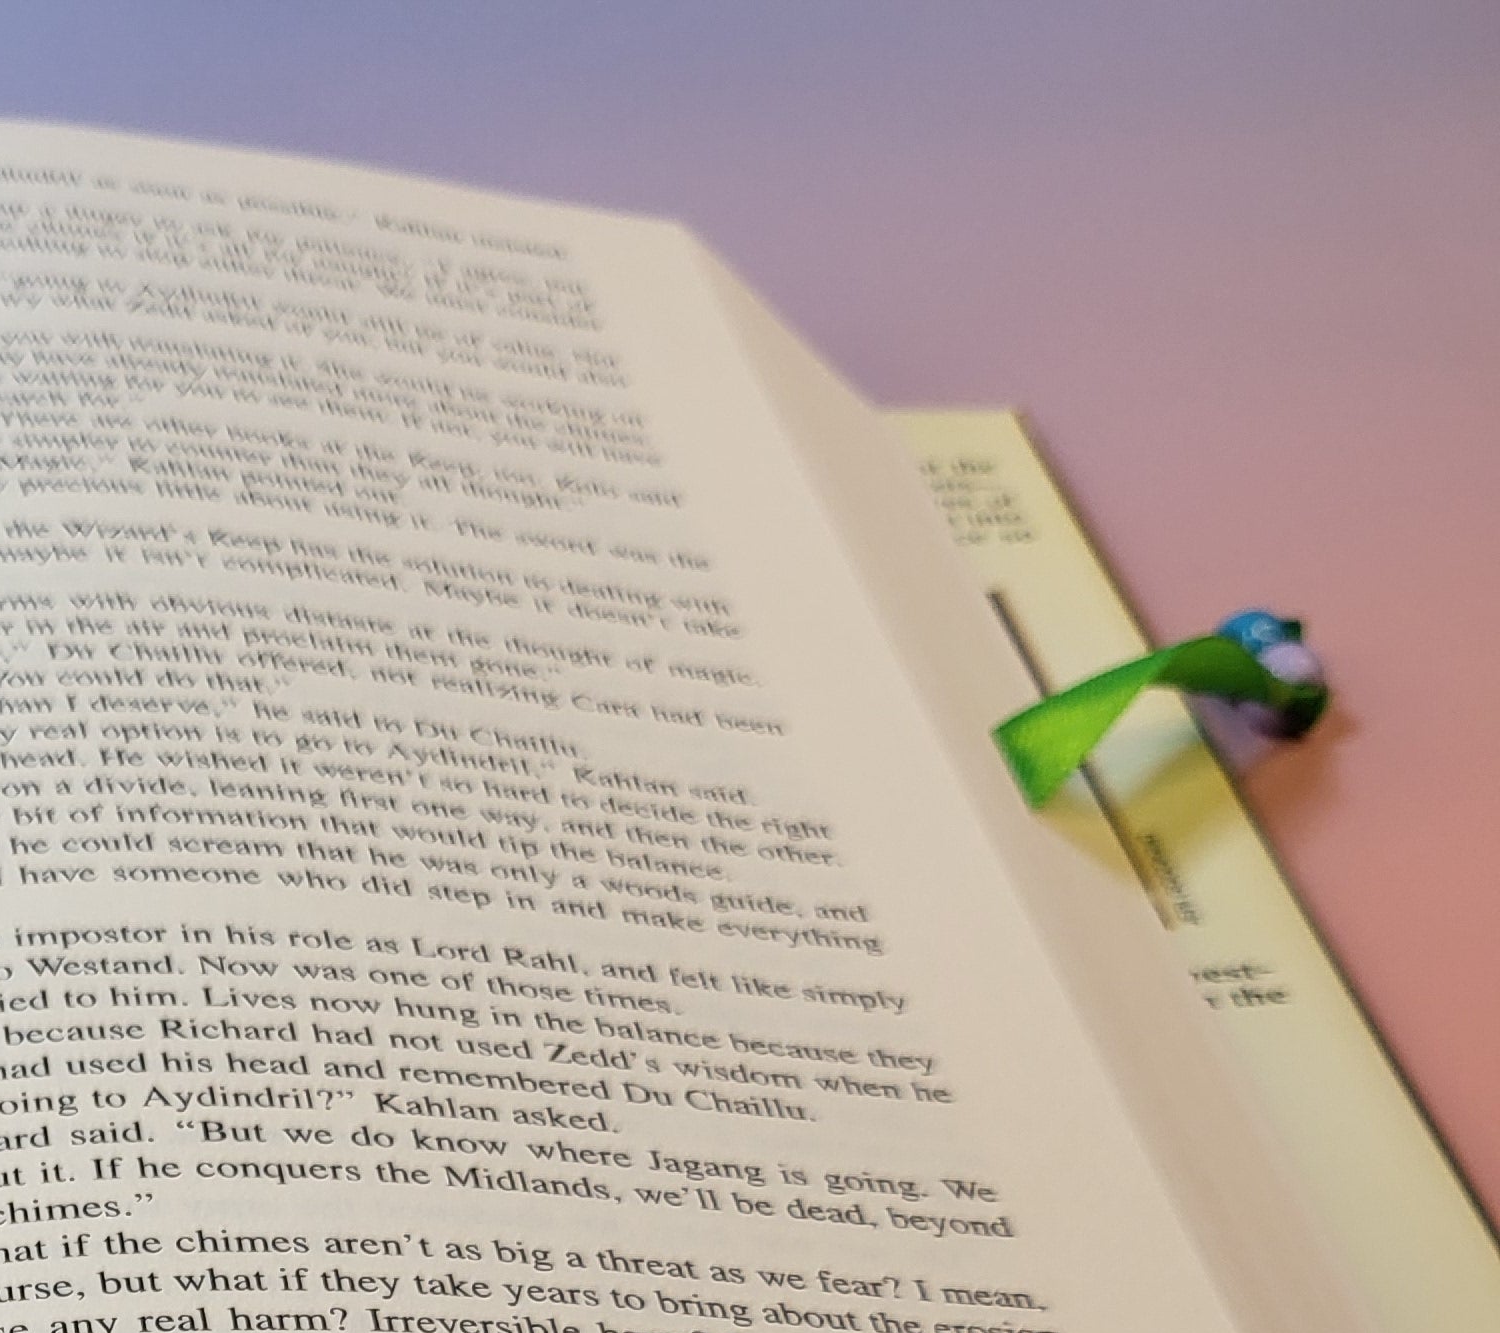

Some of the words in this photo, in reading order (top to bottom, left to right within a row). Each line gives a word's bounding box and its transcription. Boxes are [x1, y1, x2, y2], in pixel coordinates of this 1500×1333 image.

[91, 1088, 127, 1109] to
[372, 1091, 501, 1123] Kahlan
[511, 1105, 620, 1135] asked.
[61, 1232, 92, 1259] if
[102, 1230, 164, 1256] the
[175, 1228, 311, 1254] chimes
[323, 1233, 435, 1258] aren’t
[444, 1241, 483, 1262] as
[490, 1238, 556, 1273] big
[565, 1251, 588, 1269] a
[595, 1248, 701, 1281] threat
[708, 1265, 747, 1285] as
[755, 1269, 809, 1291] we
[815, 1269, 903, 1300] fear?
[911, 1278, 933, 1303] I
[939, 1287, 1049, 1313] mean,
[95, 1269, 163, 1295] but
[172, 1266, 269, 1292] what
[278, 1266, 310, 1292] if
[319, 1267, 401, 1301] they
[412, 1272, 493, 1299] take
[500, 1283, 601, 1308] years
[608, 1288, 649, 1311] to
[652, 1289, 755, 1328] bring
[761, 1301, 864, 1332] about
[136, 1306, 213, 1333] real
[226, 1305, 349, 1332] harm?
